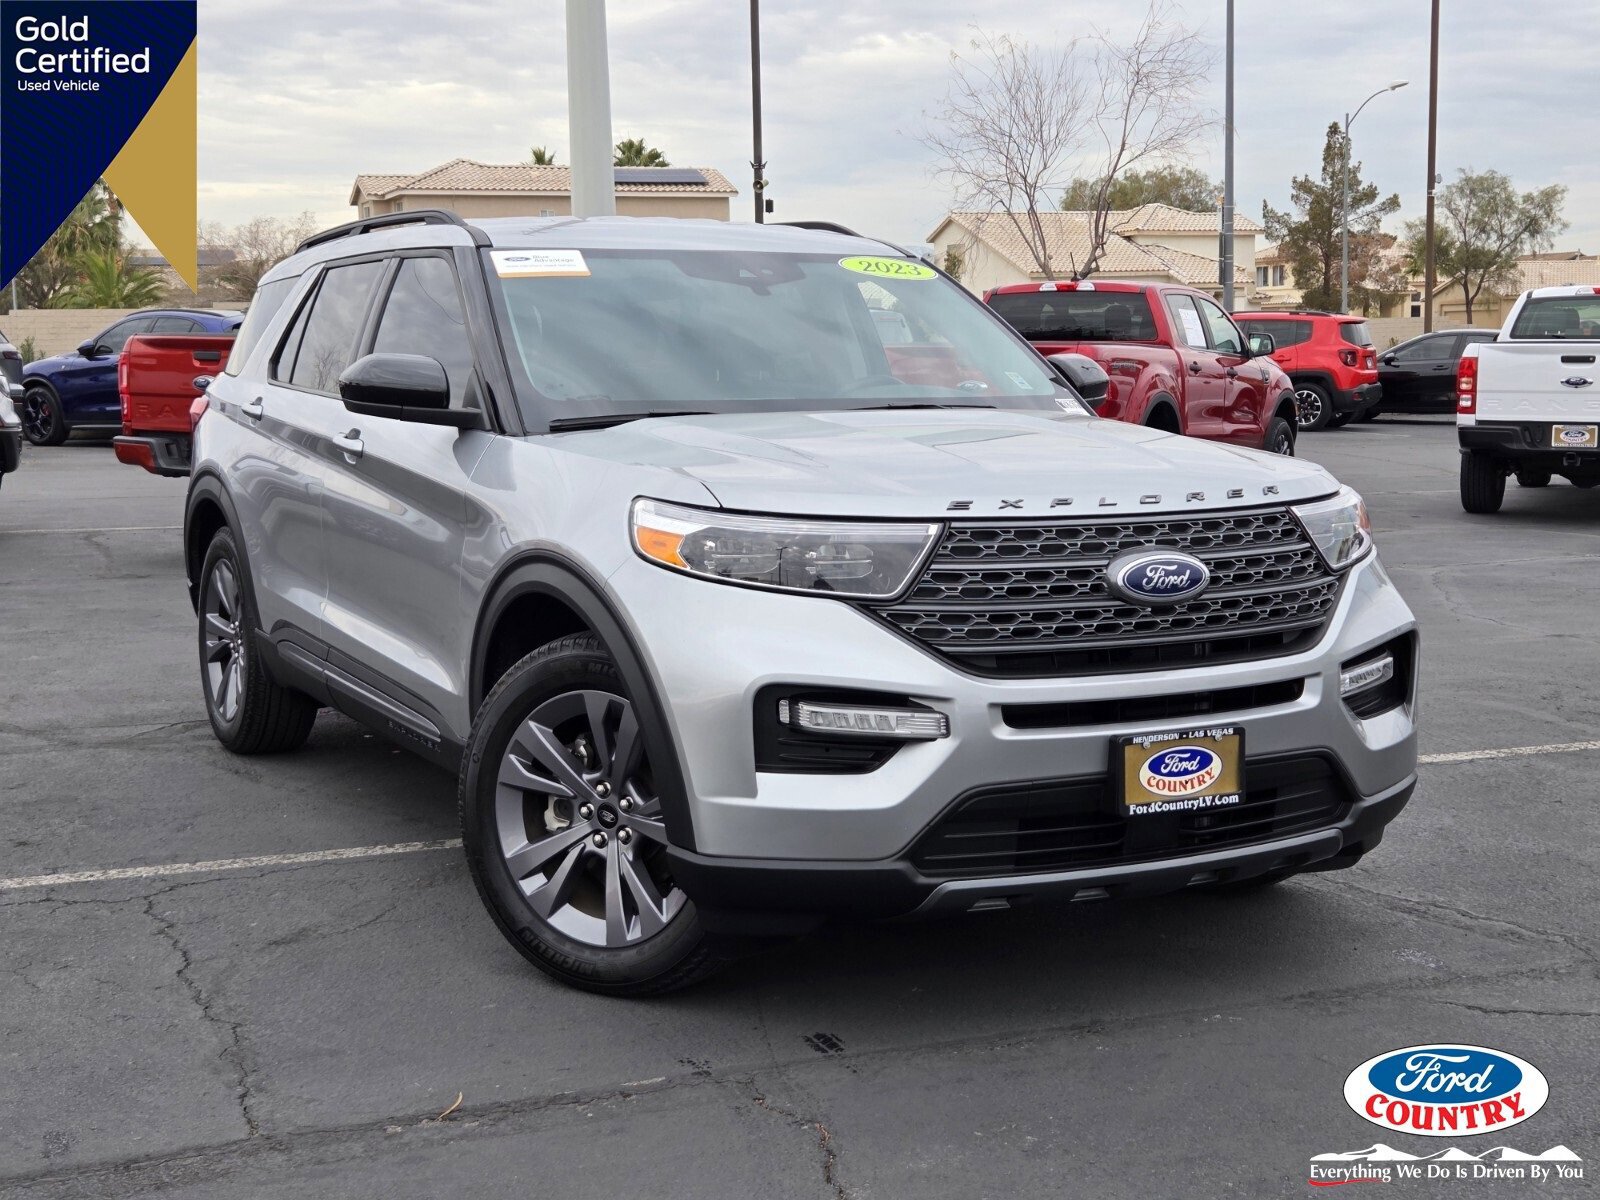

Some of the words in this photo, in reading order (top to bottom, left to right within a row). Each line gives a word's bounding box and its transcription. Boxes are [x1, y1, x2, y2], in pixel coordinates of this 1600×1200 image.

[858, 260, 922, 276] 2023
[946, 485, 1280, 511] EXPLORER
[1142, 564, 1191, 591] Ford
[1132, 732, 1180, 744] HENDERSON
[1188, 730, 1205, 739] LAS
[1207, 727, 1234, 737] VEGAS
[1160, 752, 1201, 774] Ford
[1146, 767, 1215, 793] COUNTRY
[1129, 794, 1240, 816] FordCountryLV.Com
